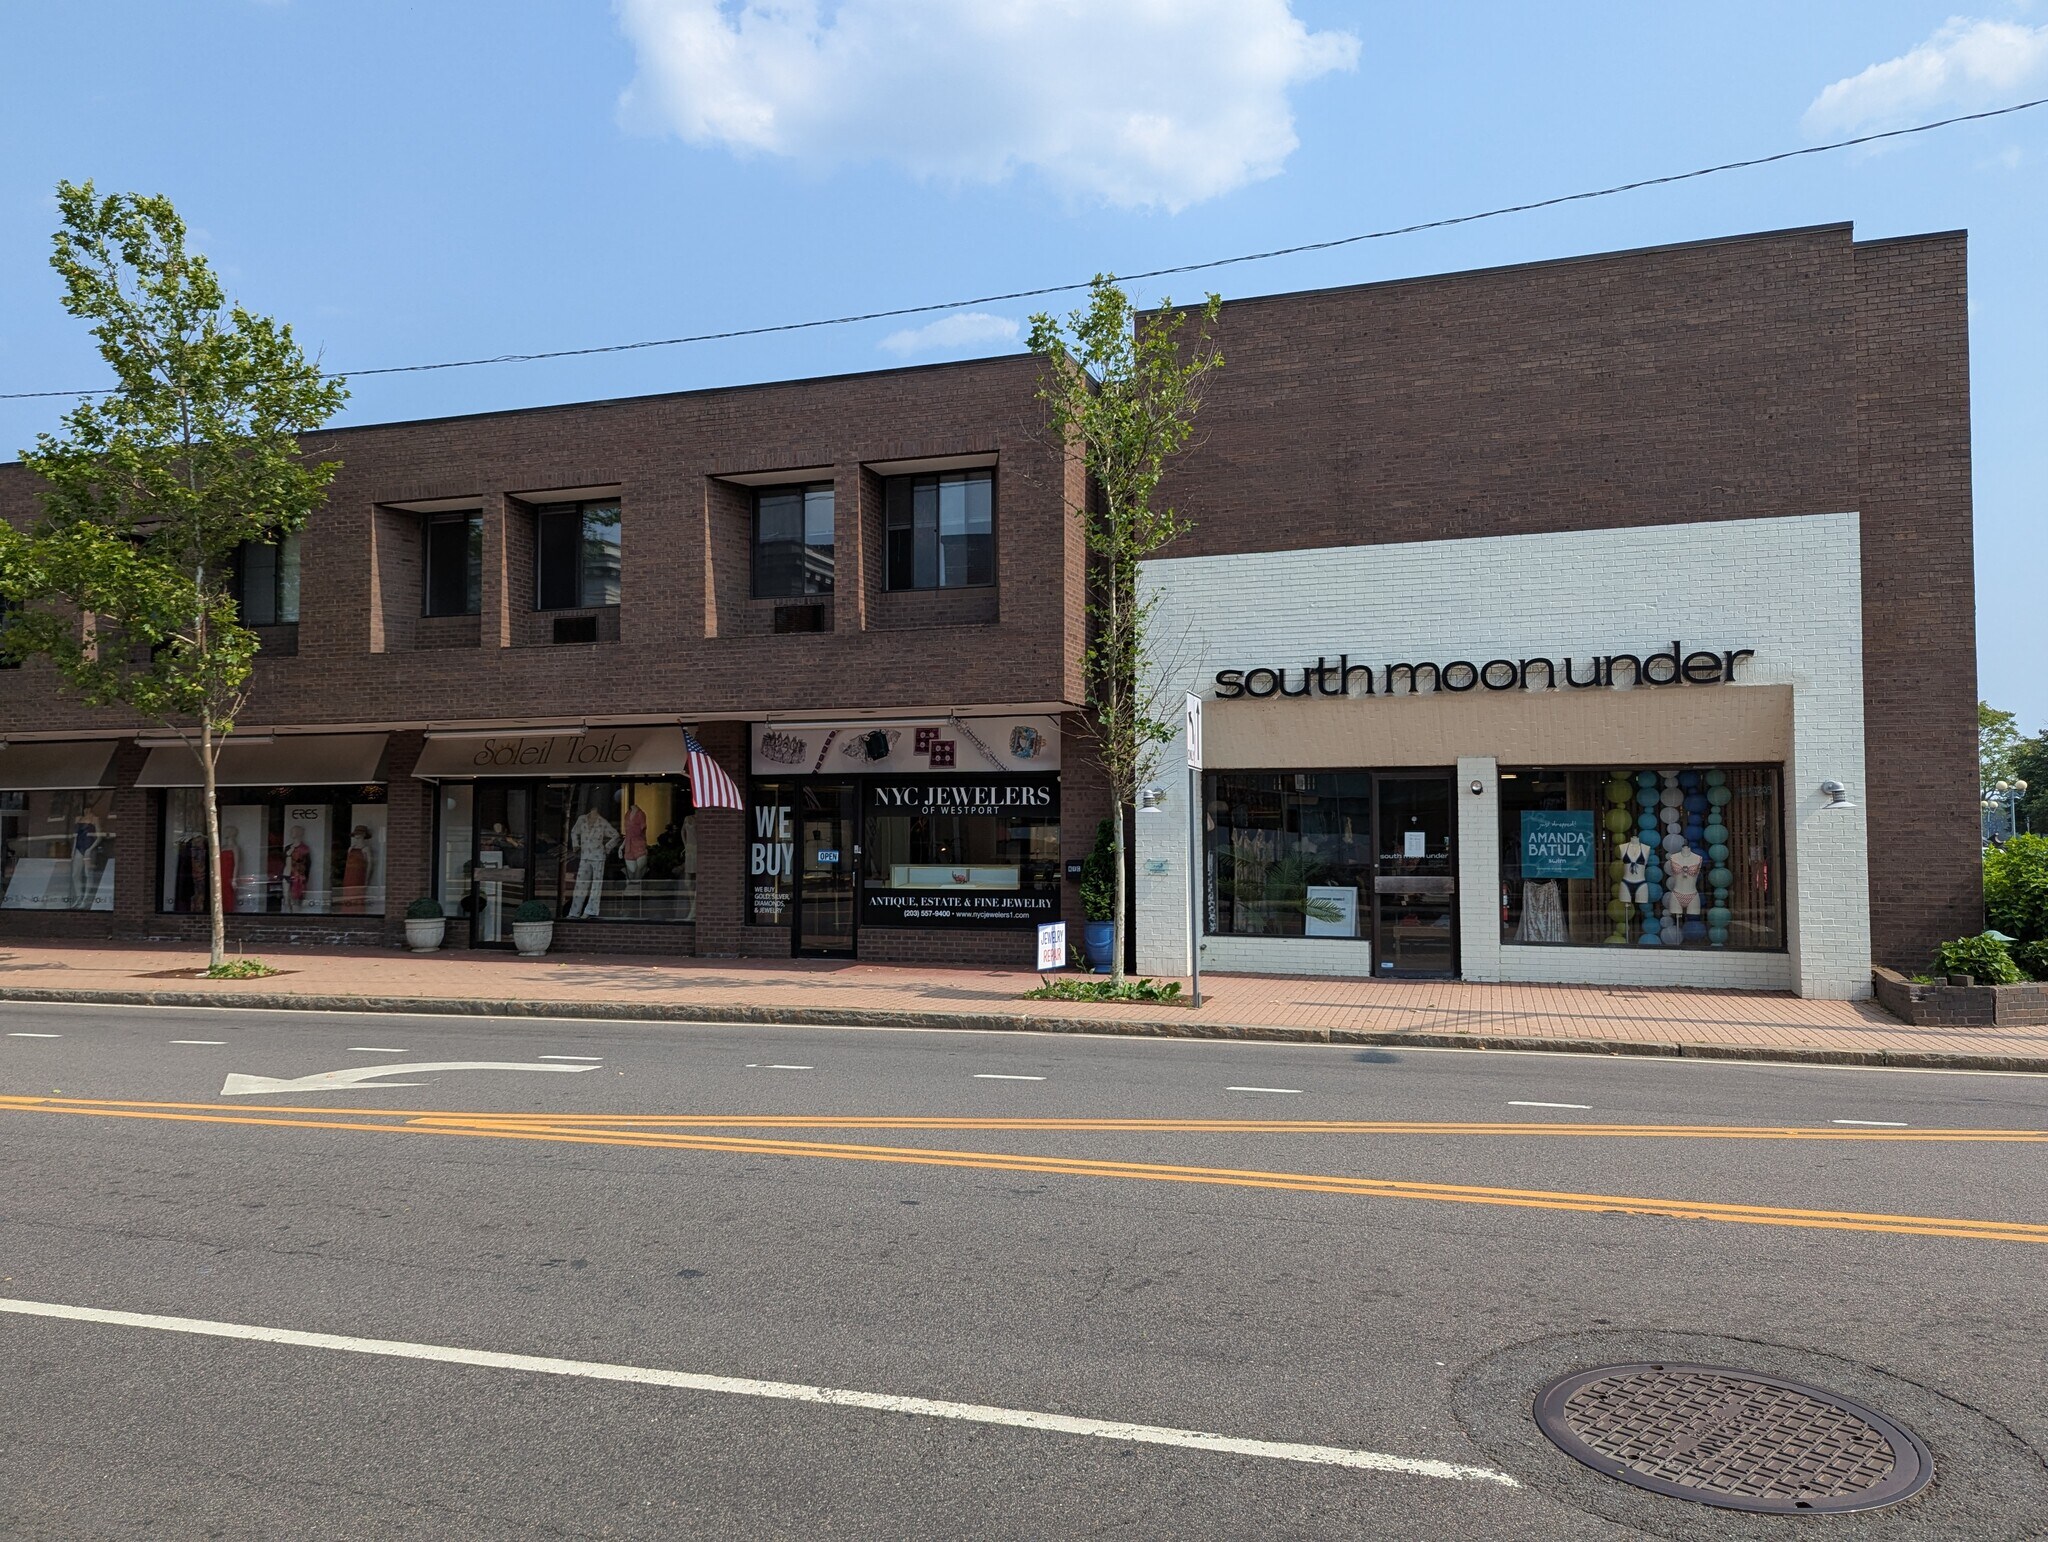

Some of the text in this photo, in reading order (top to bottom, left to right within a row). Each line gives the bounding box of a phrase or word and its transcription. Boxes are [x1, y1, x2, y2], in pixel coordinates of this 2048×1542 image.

[1215, 640, 1755, 698] south moon under
[473, 733, 632, 767] Soleil Toile
[875, 786, 1051, 807] NYC JEWELERS
[291, 808, 319, 820] ERES
[921, 806, 1000, 815] OF WESTPORT
[755, 805, 791, 838] WE
[1528, 832, 1586, 844] AMANDA
[819, 852, 838, 862] OPEN
[1528, 843, 1587, 857] BATULA
[751, 842, 794, 876] BUY
[868, 896, 1053, 909] ANTIQUE, ESTATE & FINE JEWELRY
[903, 909, 1030, 920] (203) 557-9400 www.nycjewelers1.com
[1040, 929, 1064, 946] JEWELRY
[1043, 947, 1062, 964] REPAIR
